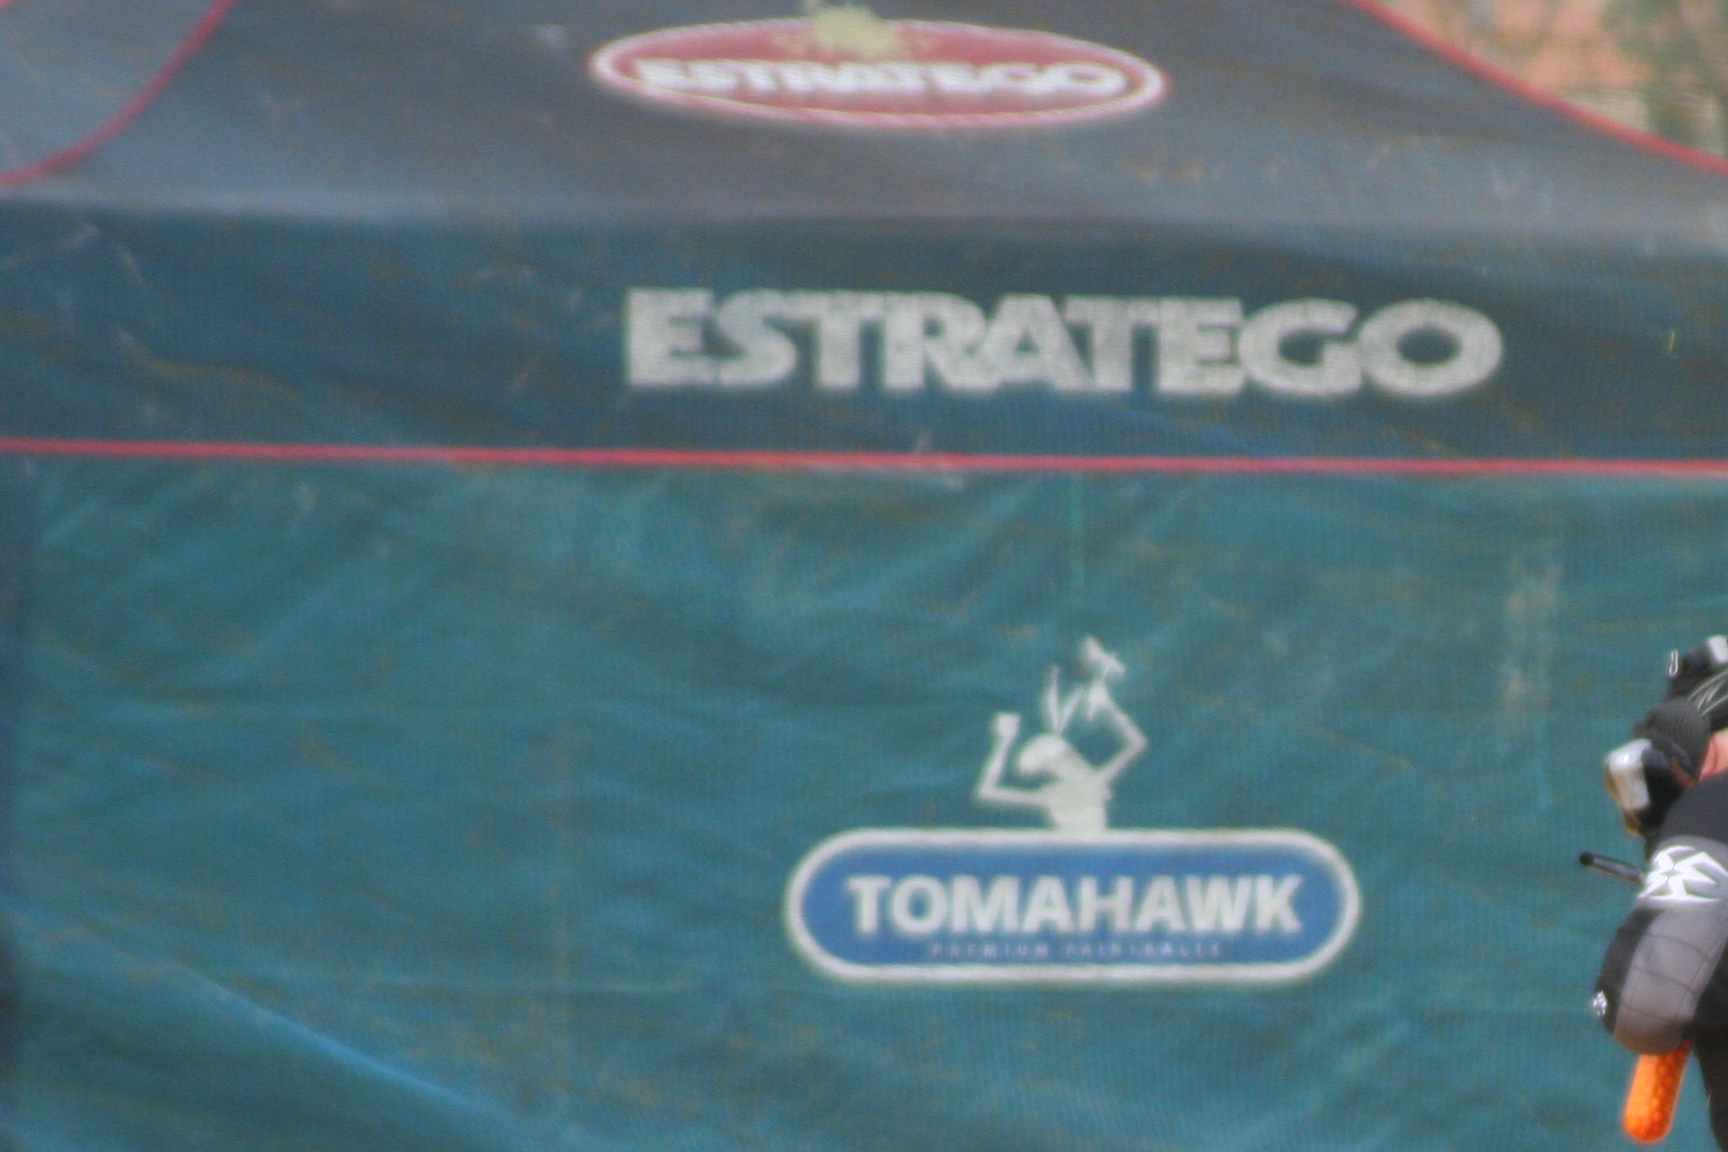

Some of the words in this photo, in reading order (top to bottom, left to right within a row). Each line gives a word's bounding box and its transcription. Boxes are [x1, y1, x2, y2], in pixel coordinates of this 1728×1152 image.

[632, 57, 1129, 97] ESTRATEGO
[625, 287, 1504, 396] ESTRATEGO
[846, 873, 1303, 936] TOMAHAWK
